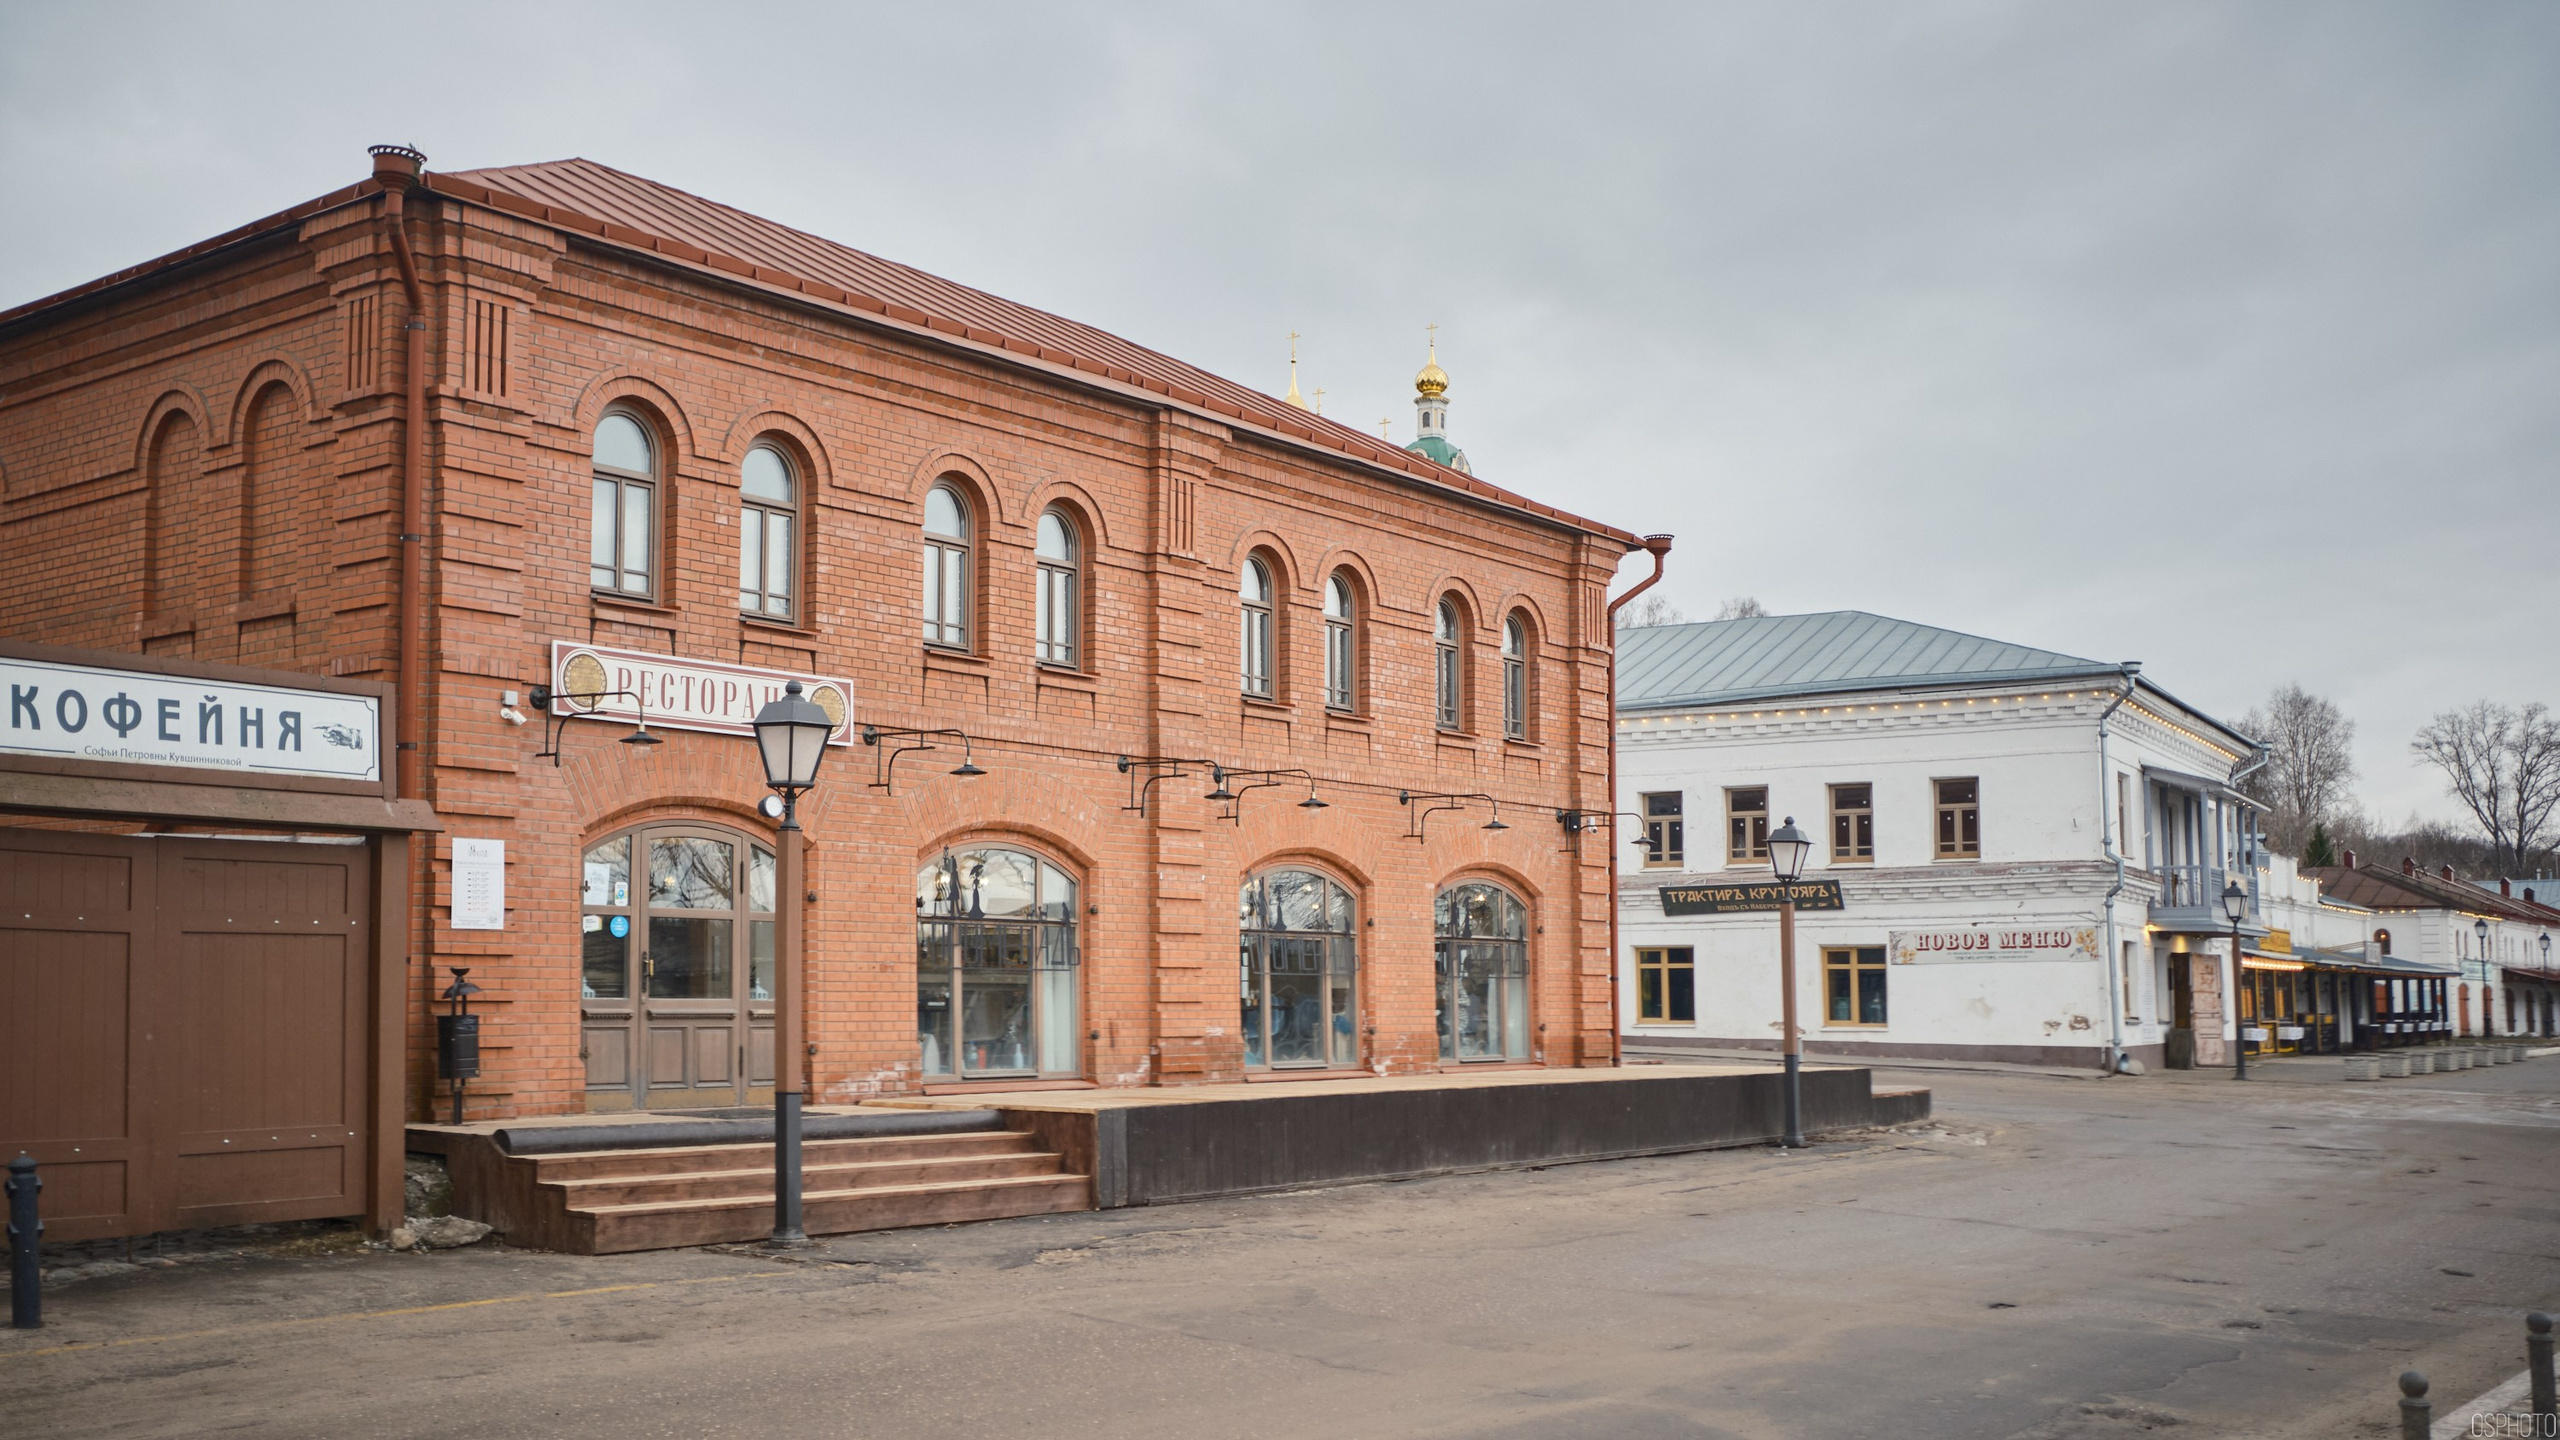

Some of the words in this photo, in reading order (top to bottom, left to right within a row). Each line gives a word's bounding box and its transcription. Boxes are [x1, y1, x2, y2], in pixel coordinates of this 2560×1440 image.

[11, 684, 302, 752] КОФЕЙНЯ
[84, 745, 118, 757] Софьи
[120, 748, 167, 761] Петровны
[169, 752, 242, 767] Кувшинниковой
[1667, 887, 1746, 904] ТРАКТИРЪ
[1749, 885, 1830, 901] КРУТОЯРЪ
[1914, 932, 1990, 951] НОВОЕ
[2000, 930, 2072, 950] МЕНЮ
